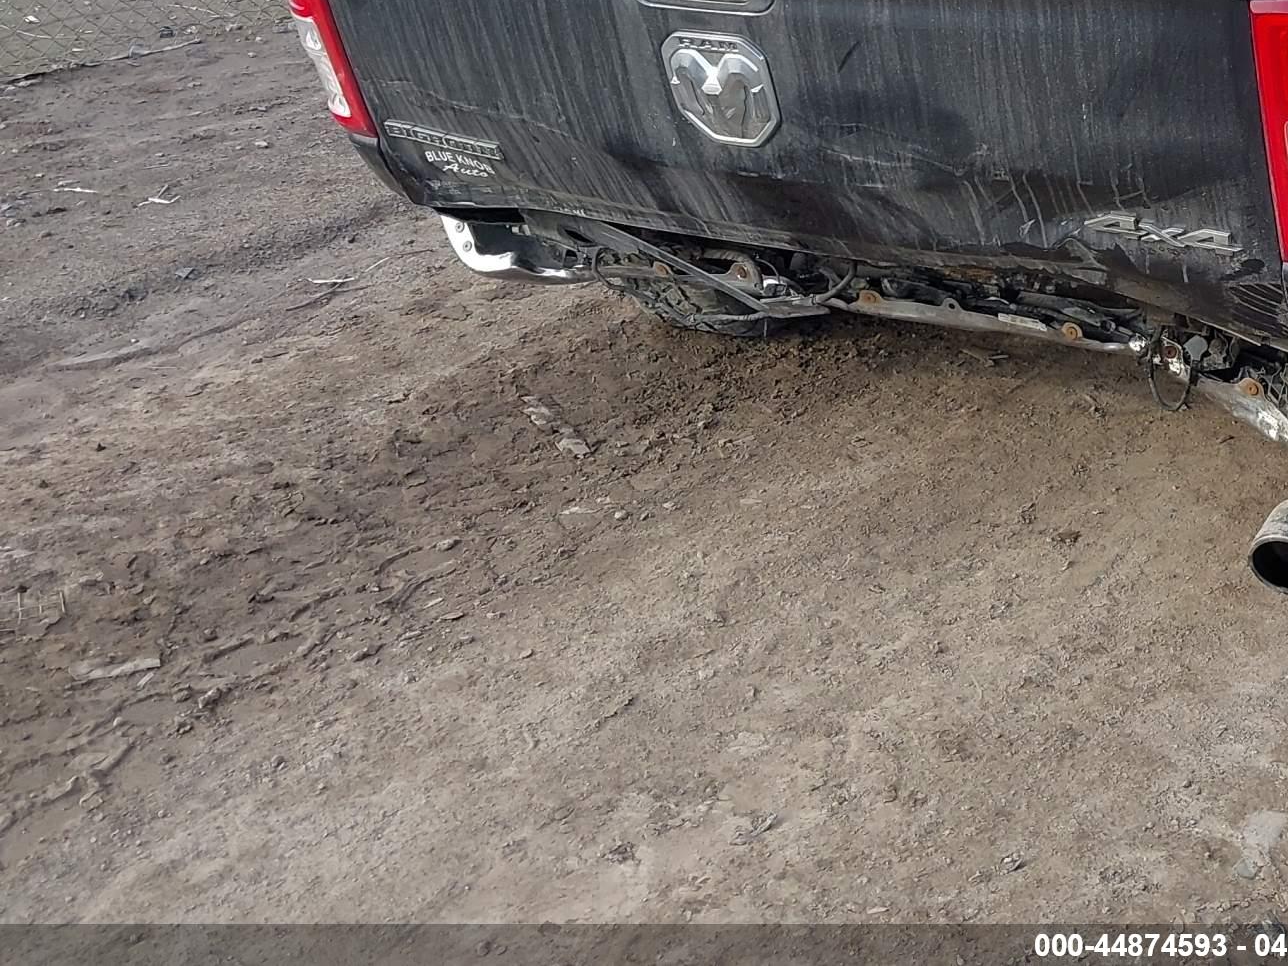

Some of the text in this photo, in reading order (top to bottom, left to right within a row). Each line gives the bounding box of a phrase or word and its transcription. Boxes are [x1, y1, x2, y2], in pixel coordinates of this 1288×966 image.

[678, 37, 739, 52] RAM
[424, 150, 497, 174] BLUE KNOB
[442, 163, 489, 178] Auto
